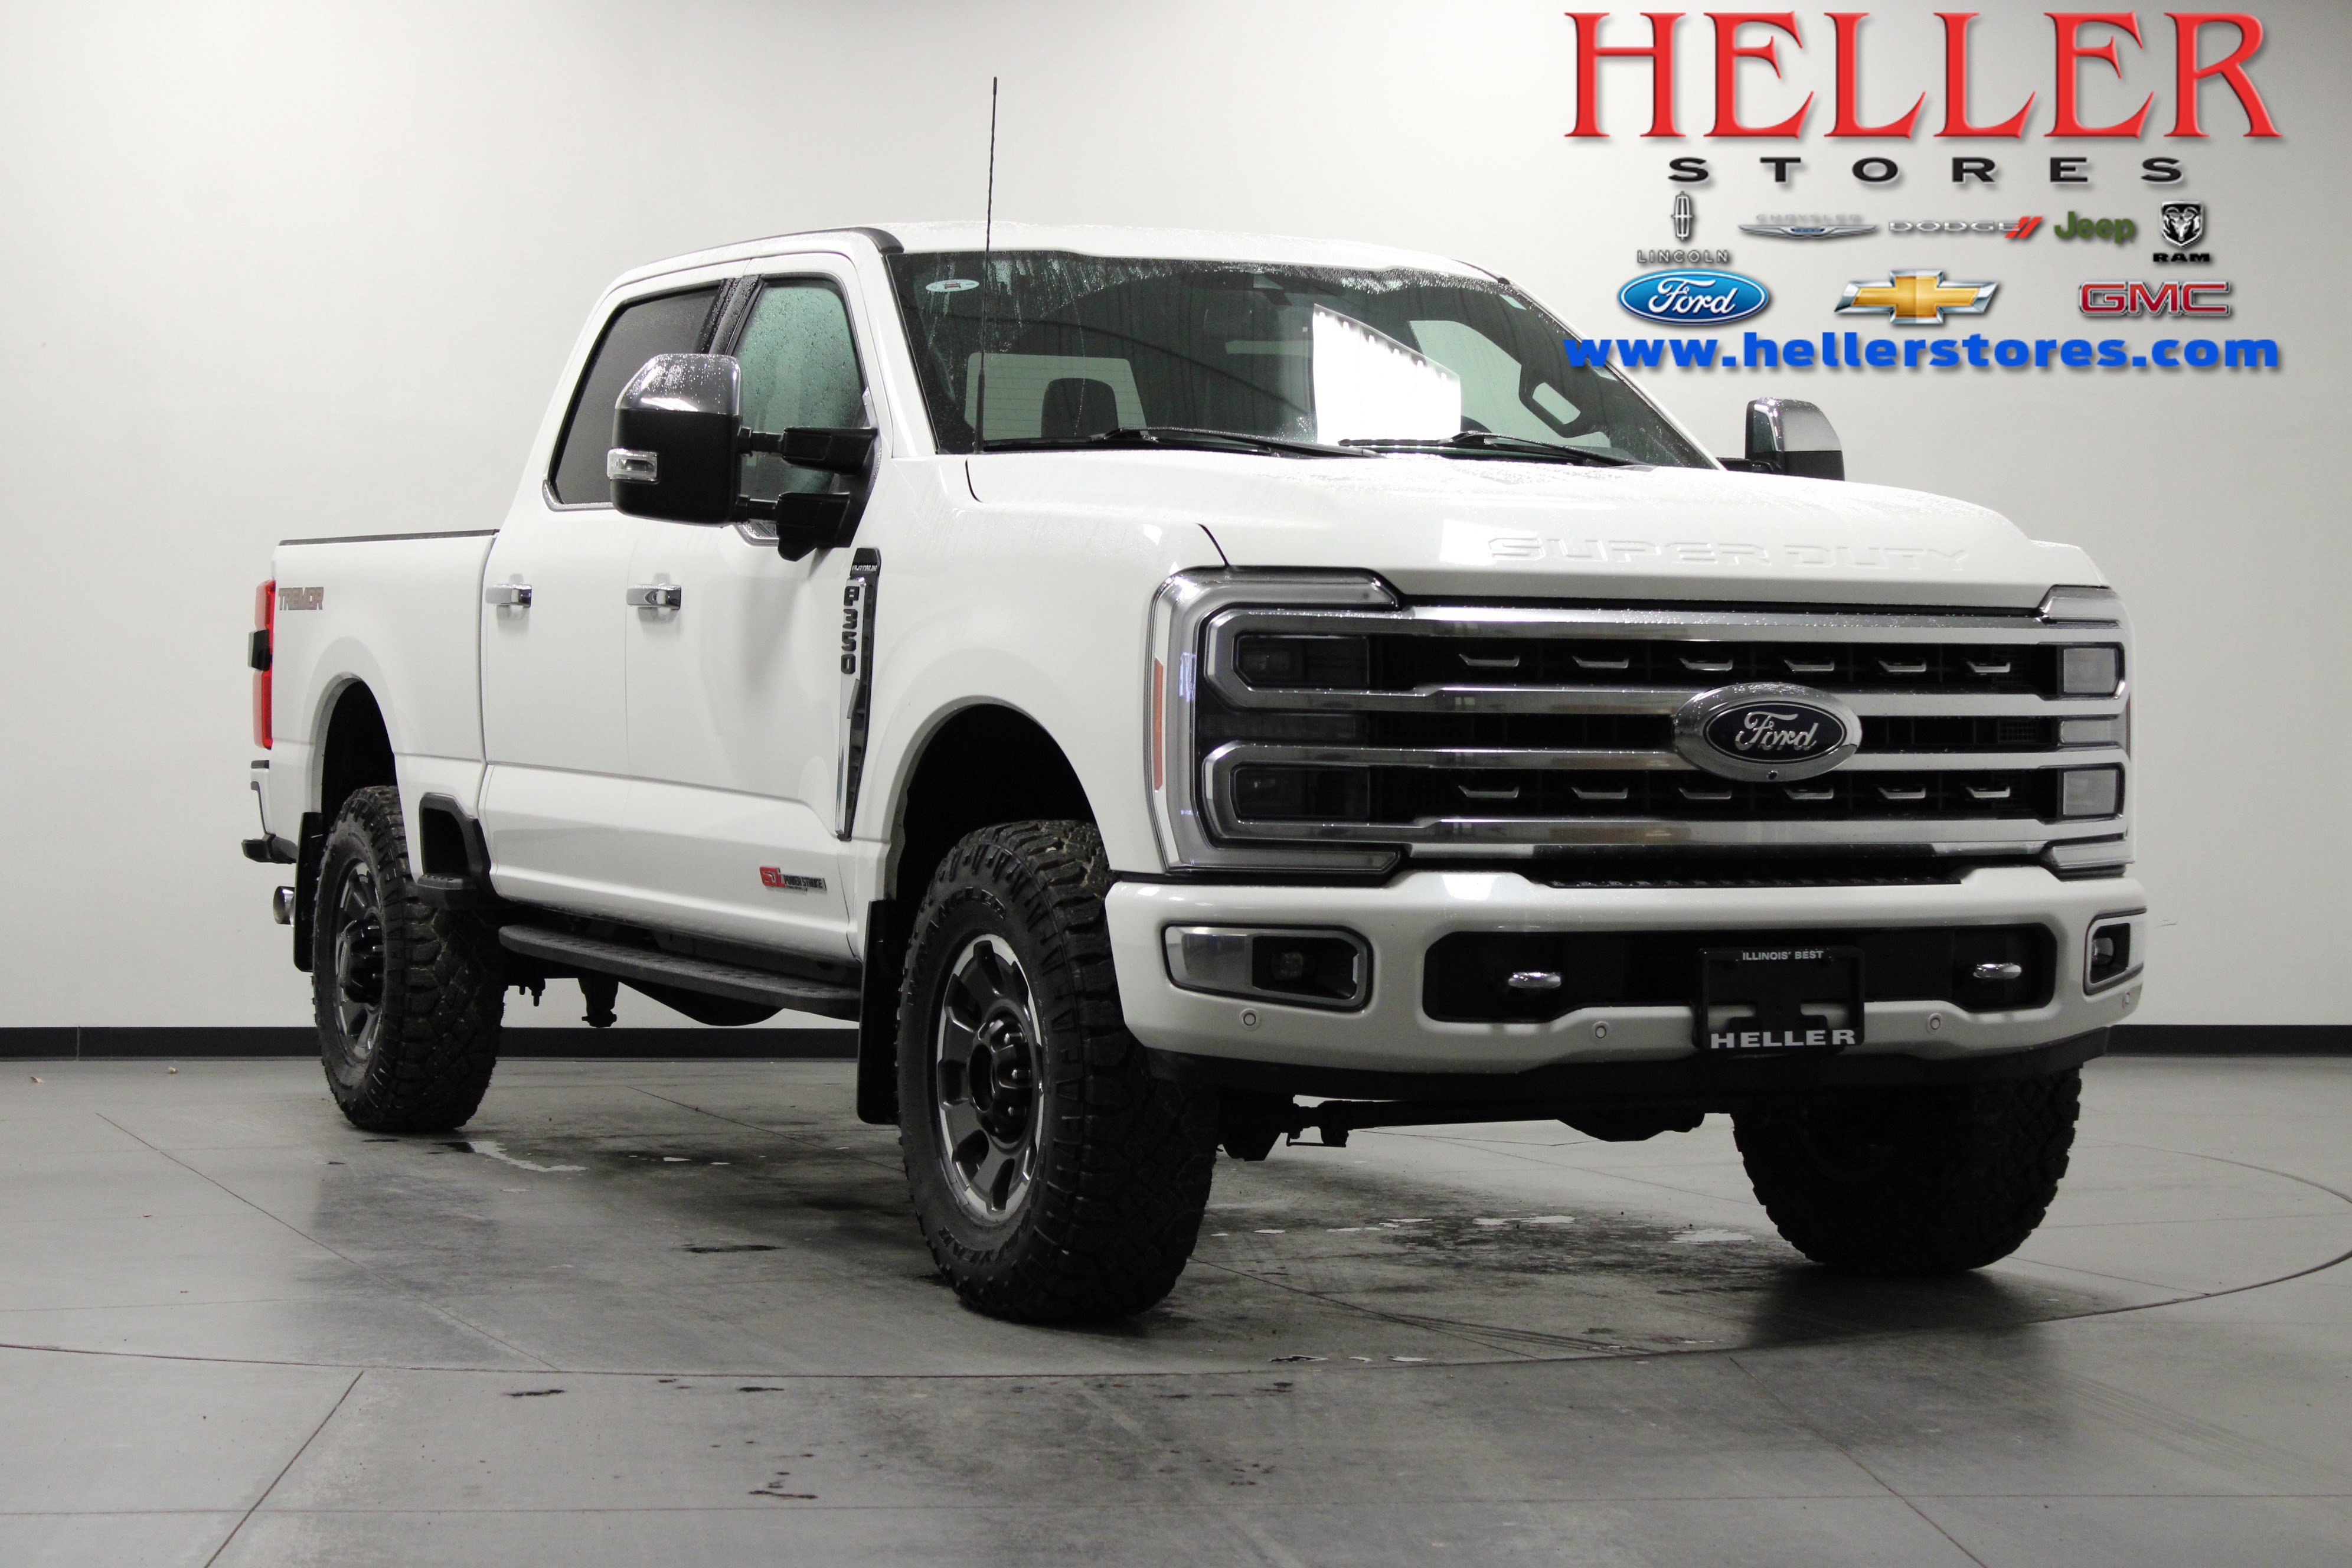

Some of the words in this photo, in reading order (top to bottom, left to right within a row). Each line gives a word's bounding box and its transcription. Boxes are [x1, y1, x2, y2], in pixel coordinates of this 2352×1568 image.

[1487, 537, 1772, 566] SUPER
[1783, 544, 1969, 571] DUTY
[278, 587, 324, 610] TREMOR
[1734, 711, 1819, 751] Ford
[1795, 950, 1824, 959] BEST
[1711, 1029, 1856, 1049] HELLER
